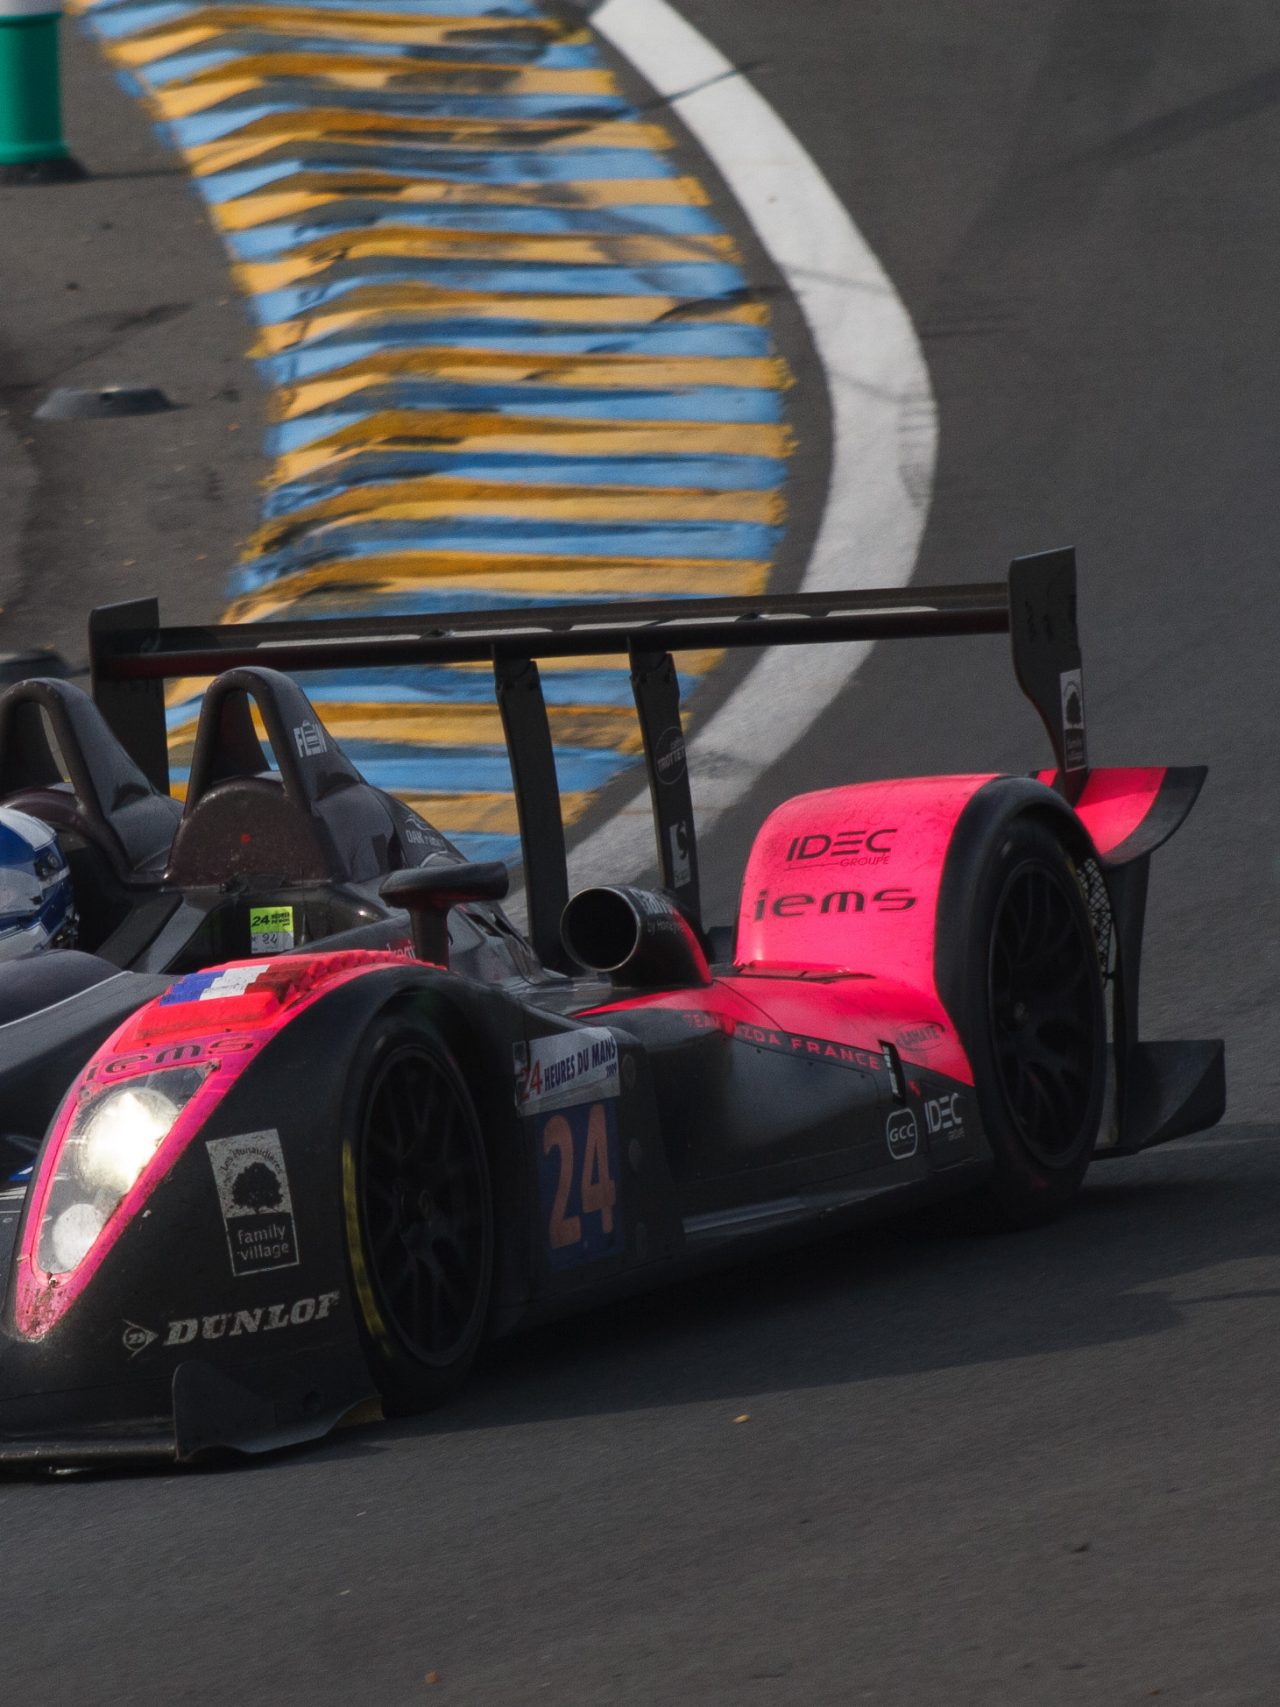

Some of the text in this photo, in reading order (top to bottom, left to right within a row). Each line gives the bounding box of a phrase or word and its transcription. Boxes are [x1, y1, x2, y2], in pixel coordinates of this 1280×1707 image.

[786, 829, 898, 861] IDEC
[840, 855, 890, 867] GROUPE
[252, 915, 270, 927] 24
[754, 888, 917, 922] iems
[543, 1054, 576, 1092] HEURES
[577, 1047, 589, 1075] DU
[591, 1035, 616, 1069] MANS
[791, 1038, 881, 1070] FRANCE
[924, 1093, 963, 1134] IDEC
[889, 1123, 915, 1143] GCC
[542, 1103, 617, 1250] 24
[237, 1223, 286, 1245] family
[239, 1241, 290, 1261] village
